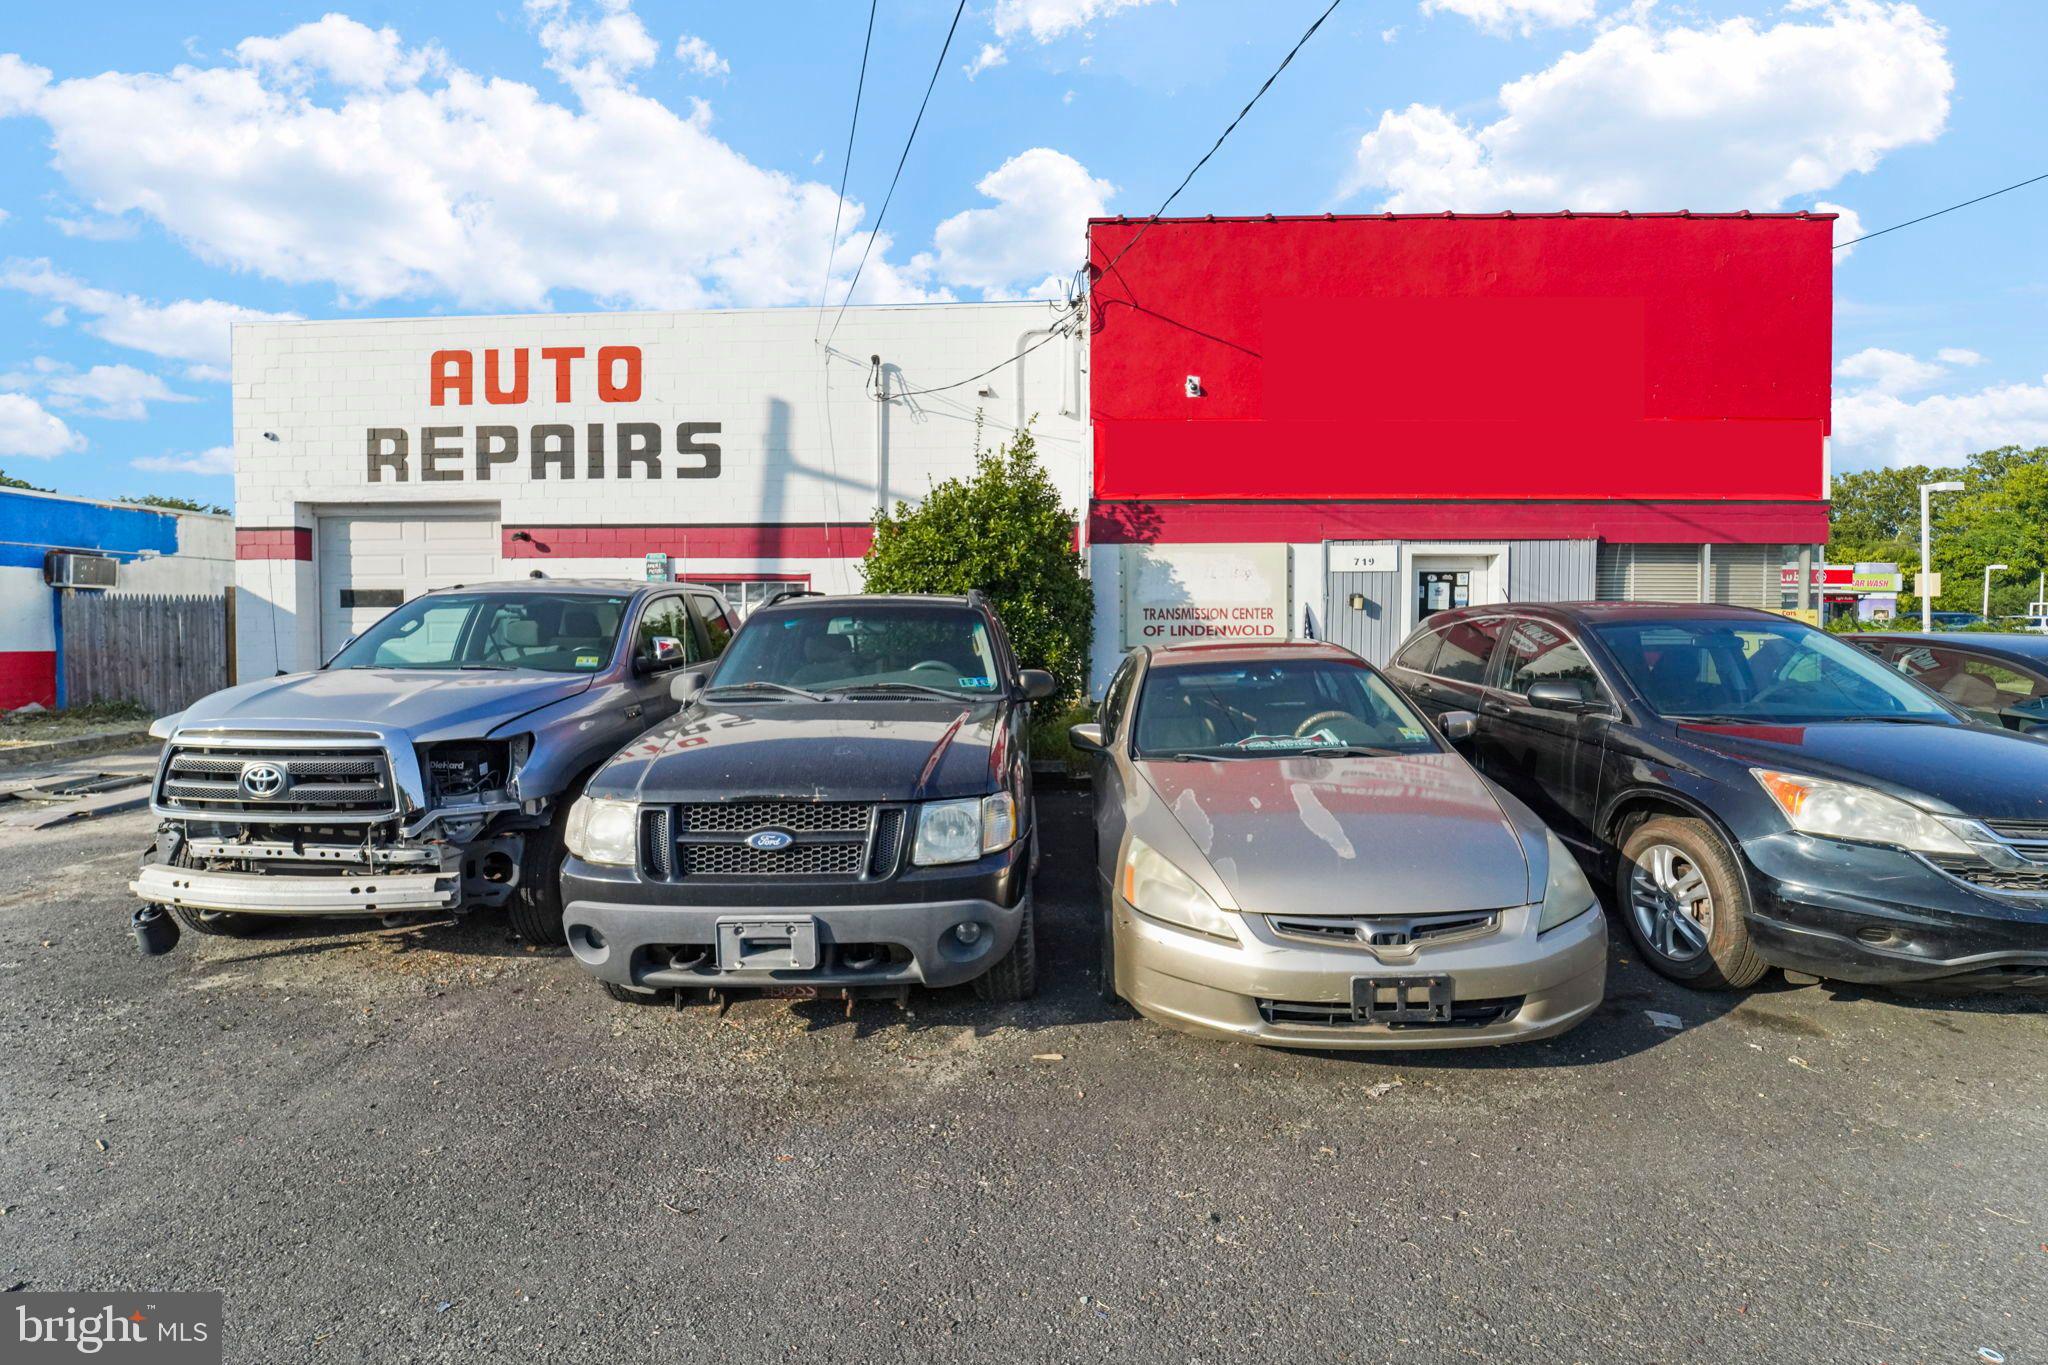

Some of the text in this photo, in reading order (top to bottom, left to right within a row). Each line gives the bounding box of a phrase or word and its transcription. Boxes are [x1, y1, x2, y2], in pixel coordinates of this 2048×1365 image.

[430, 345, 642, 406] AUTO
[367, 422, 722, 482] REPAIRS
[1353, 557, 1375, 566] 719
[1780, 571, 1798, 581] Lub
[1867, 579, 1888, 588] WASH
[1143, 607, 1274, 621] TRANSMISSION CENTER
[1143, 624, 1275, 637] OF LINDENWOLD
[429, 761, 465, 770] DieHard
[757, 834, 782, 846] Ford
